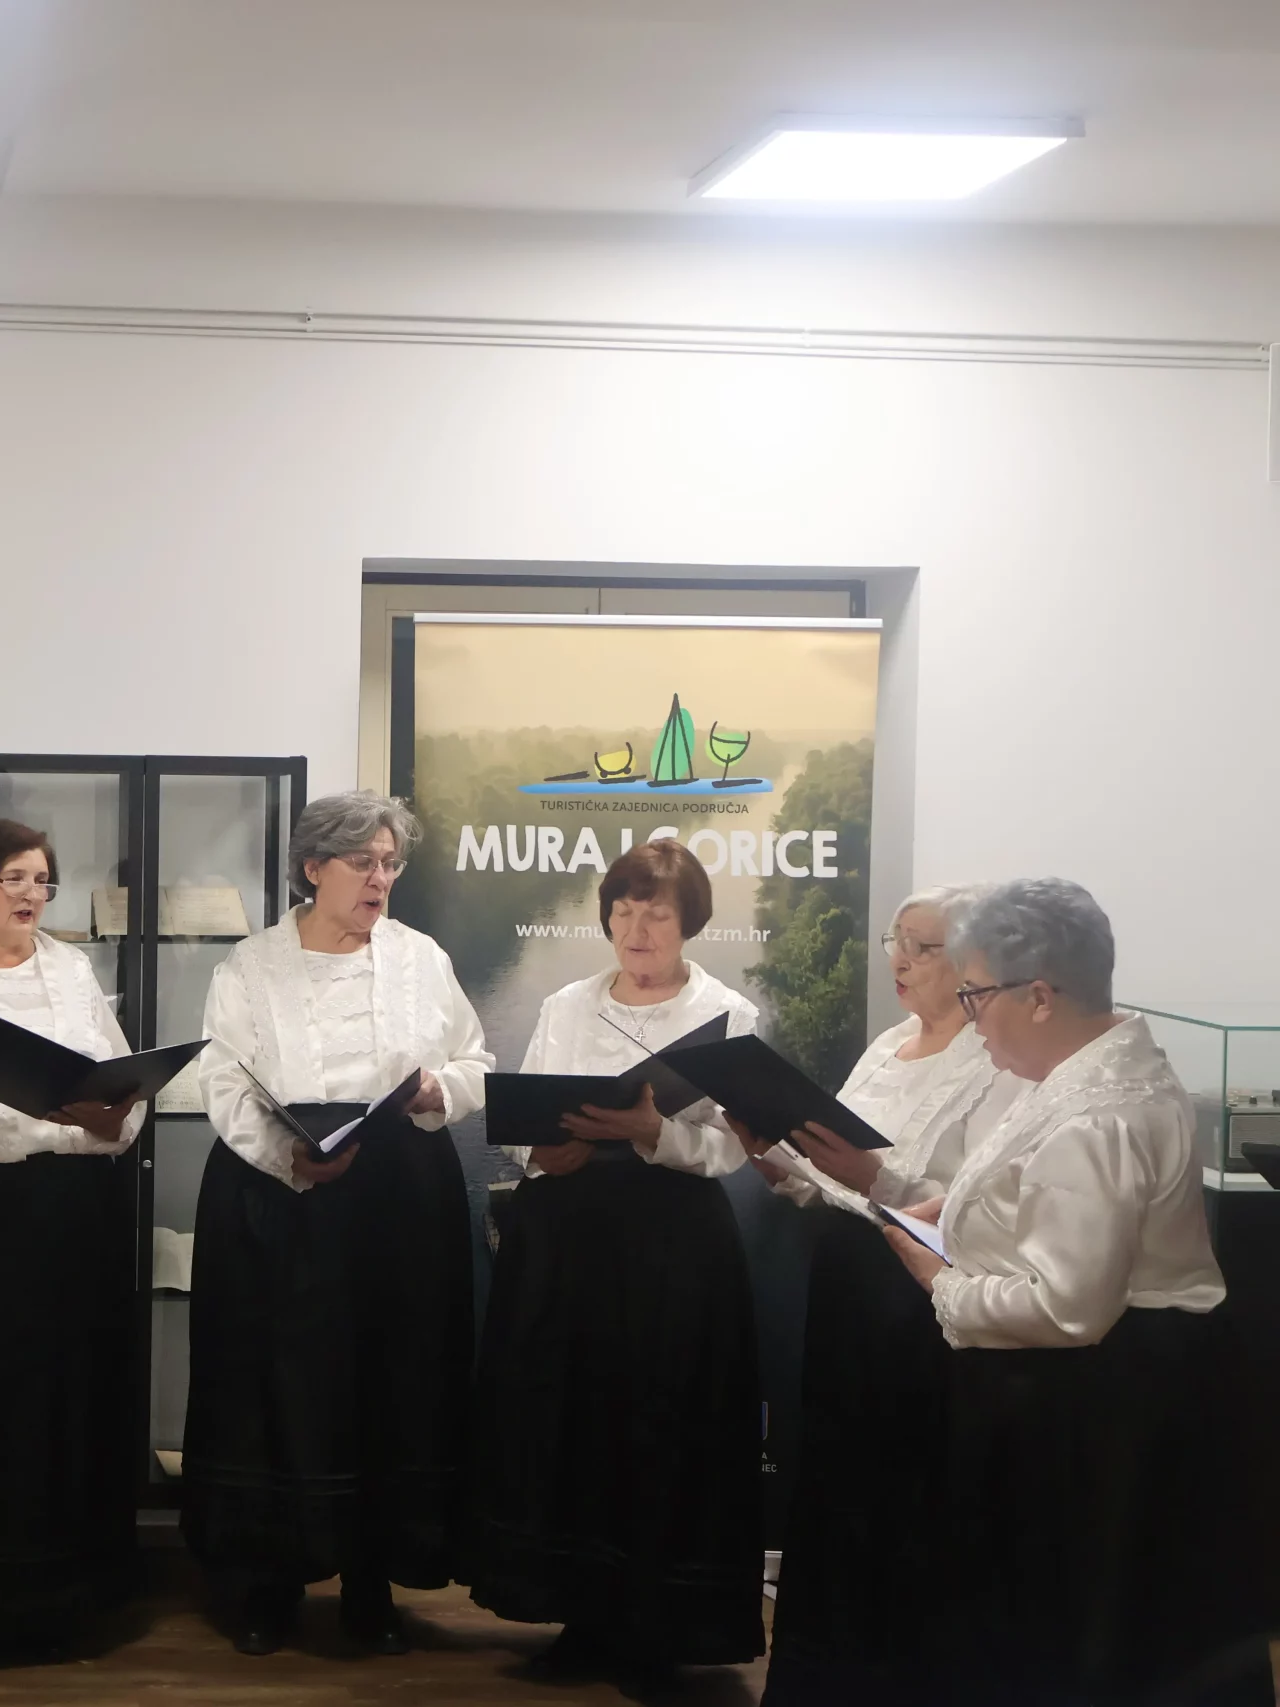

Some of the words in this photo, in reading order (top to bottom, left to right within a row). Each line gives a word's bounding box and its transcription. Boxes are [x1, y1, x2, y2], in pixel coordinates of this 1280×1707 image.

[540, 799, 609, 812] TURISTIČKA
[612, 801, 679, 814] ZAJEDNICA
[682, 801, 749, 814] PODRUČJA
[455, 824, 608, 874] MURA
